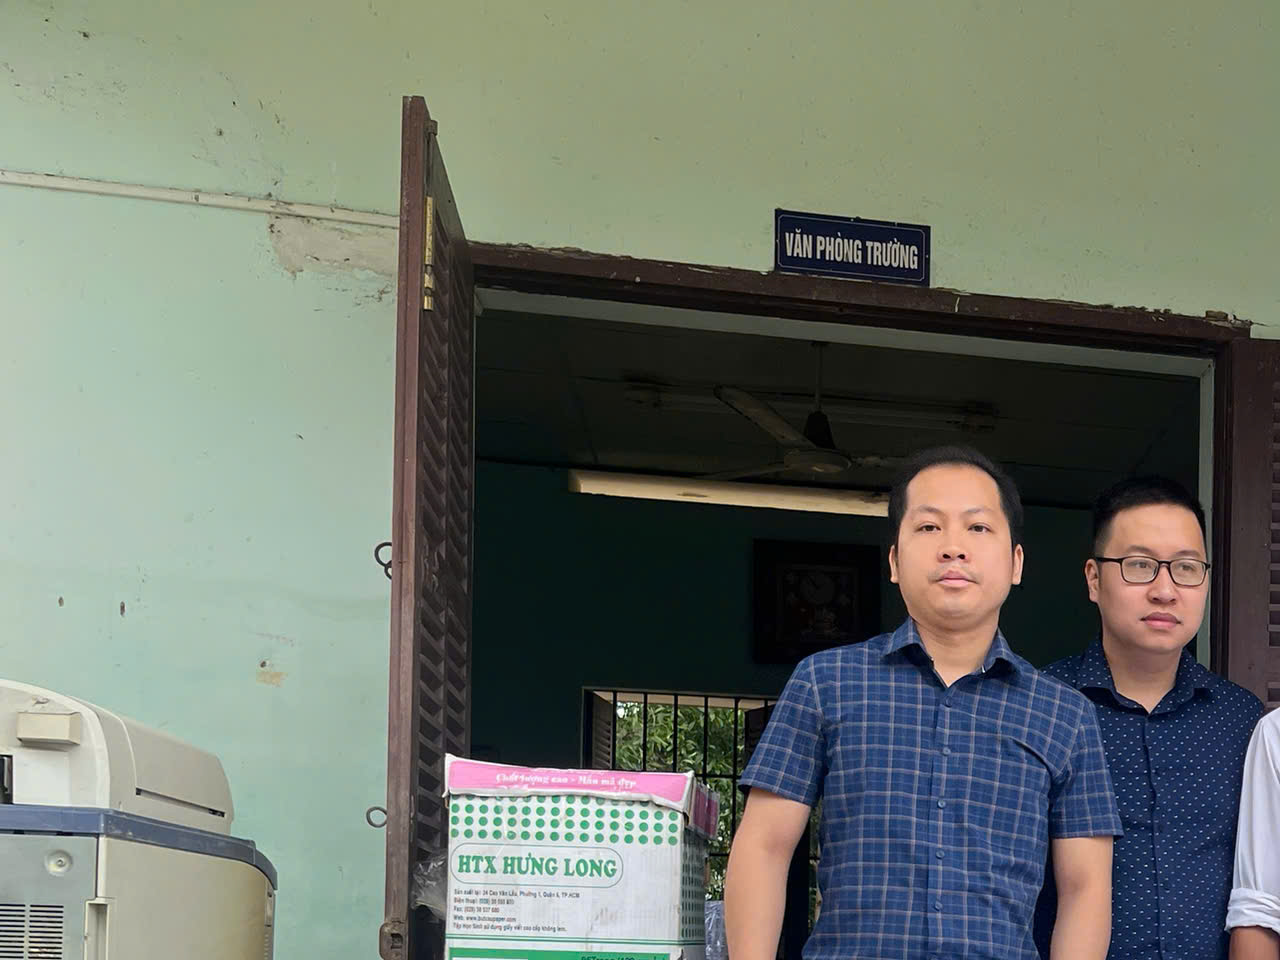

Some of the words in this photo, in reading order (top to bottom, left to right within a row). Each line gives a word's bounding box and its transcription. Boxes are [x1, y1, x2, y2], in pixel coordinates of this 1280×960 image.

[785, 228, 812, 259] VĂN
[816, 232, 862, 264] PHÒNG
[866, 238, 918, 269] TRƯỜNG
[458, 854, 497, 874] HTX
[502, 852, 558, 876] HƯNG
[564, 858, 617, 877] LONG
